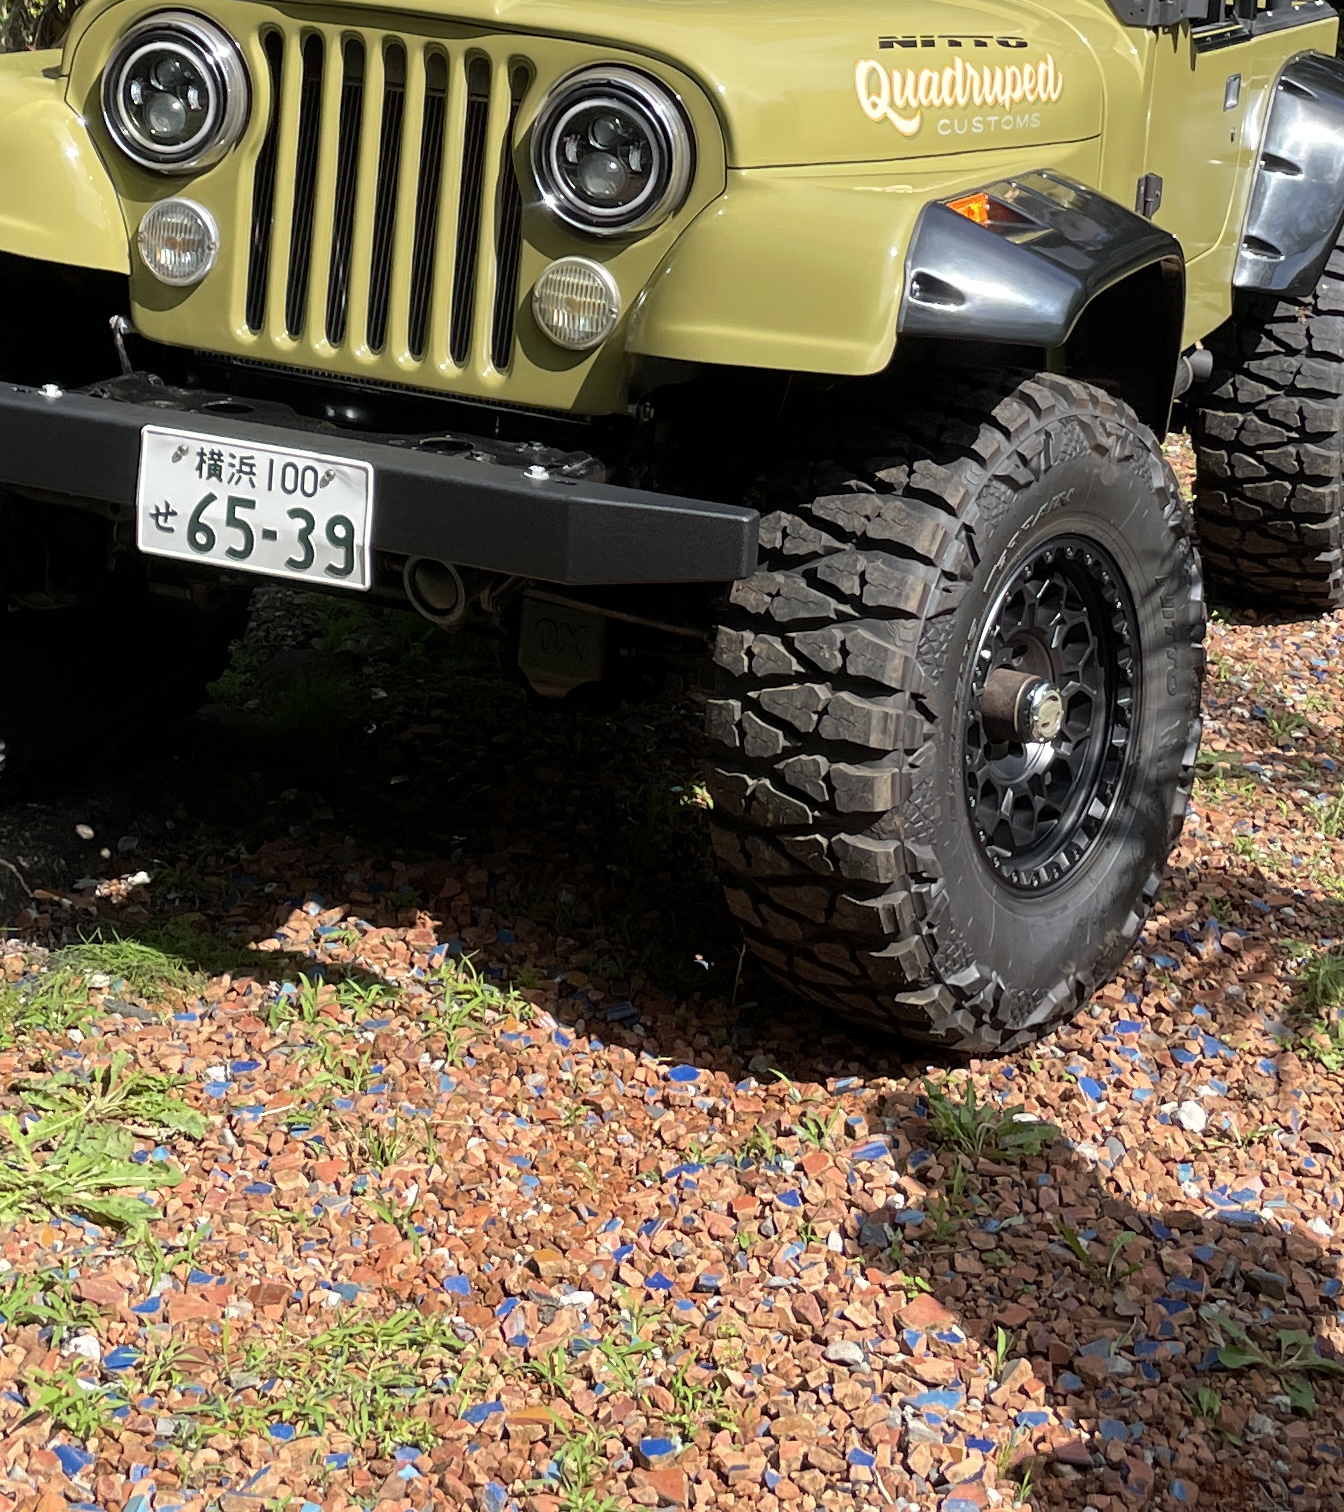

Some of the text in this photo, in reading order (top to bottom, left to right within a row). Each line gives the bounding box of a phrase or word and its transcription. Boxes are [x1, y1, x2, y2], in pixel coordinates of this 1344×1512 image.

[878, 35, 1028, 49] NITTO
[855, 53, 1063, 137] Quadruped
[937, 113, 1041, 136] CUSTOMS
[195, 446, 318, 498] 横浜 100
[149, 492, 355, 577] せ 65-39
